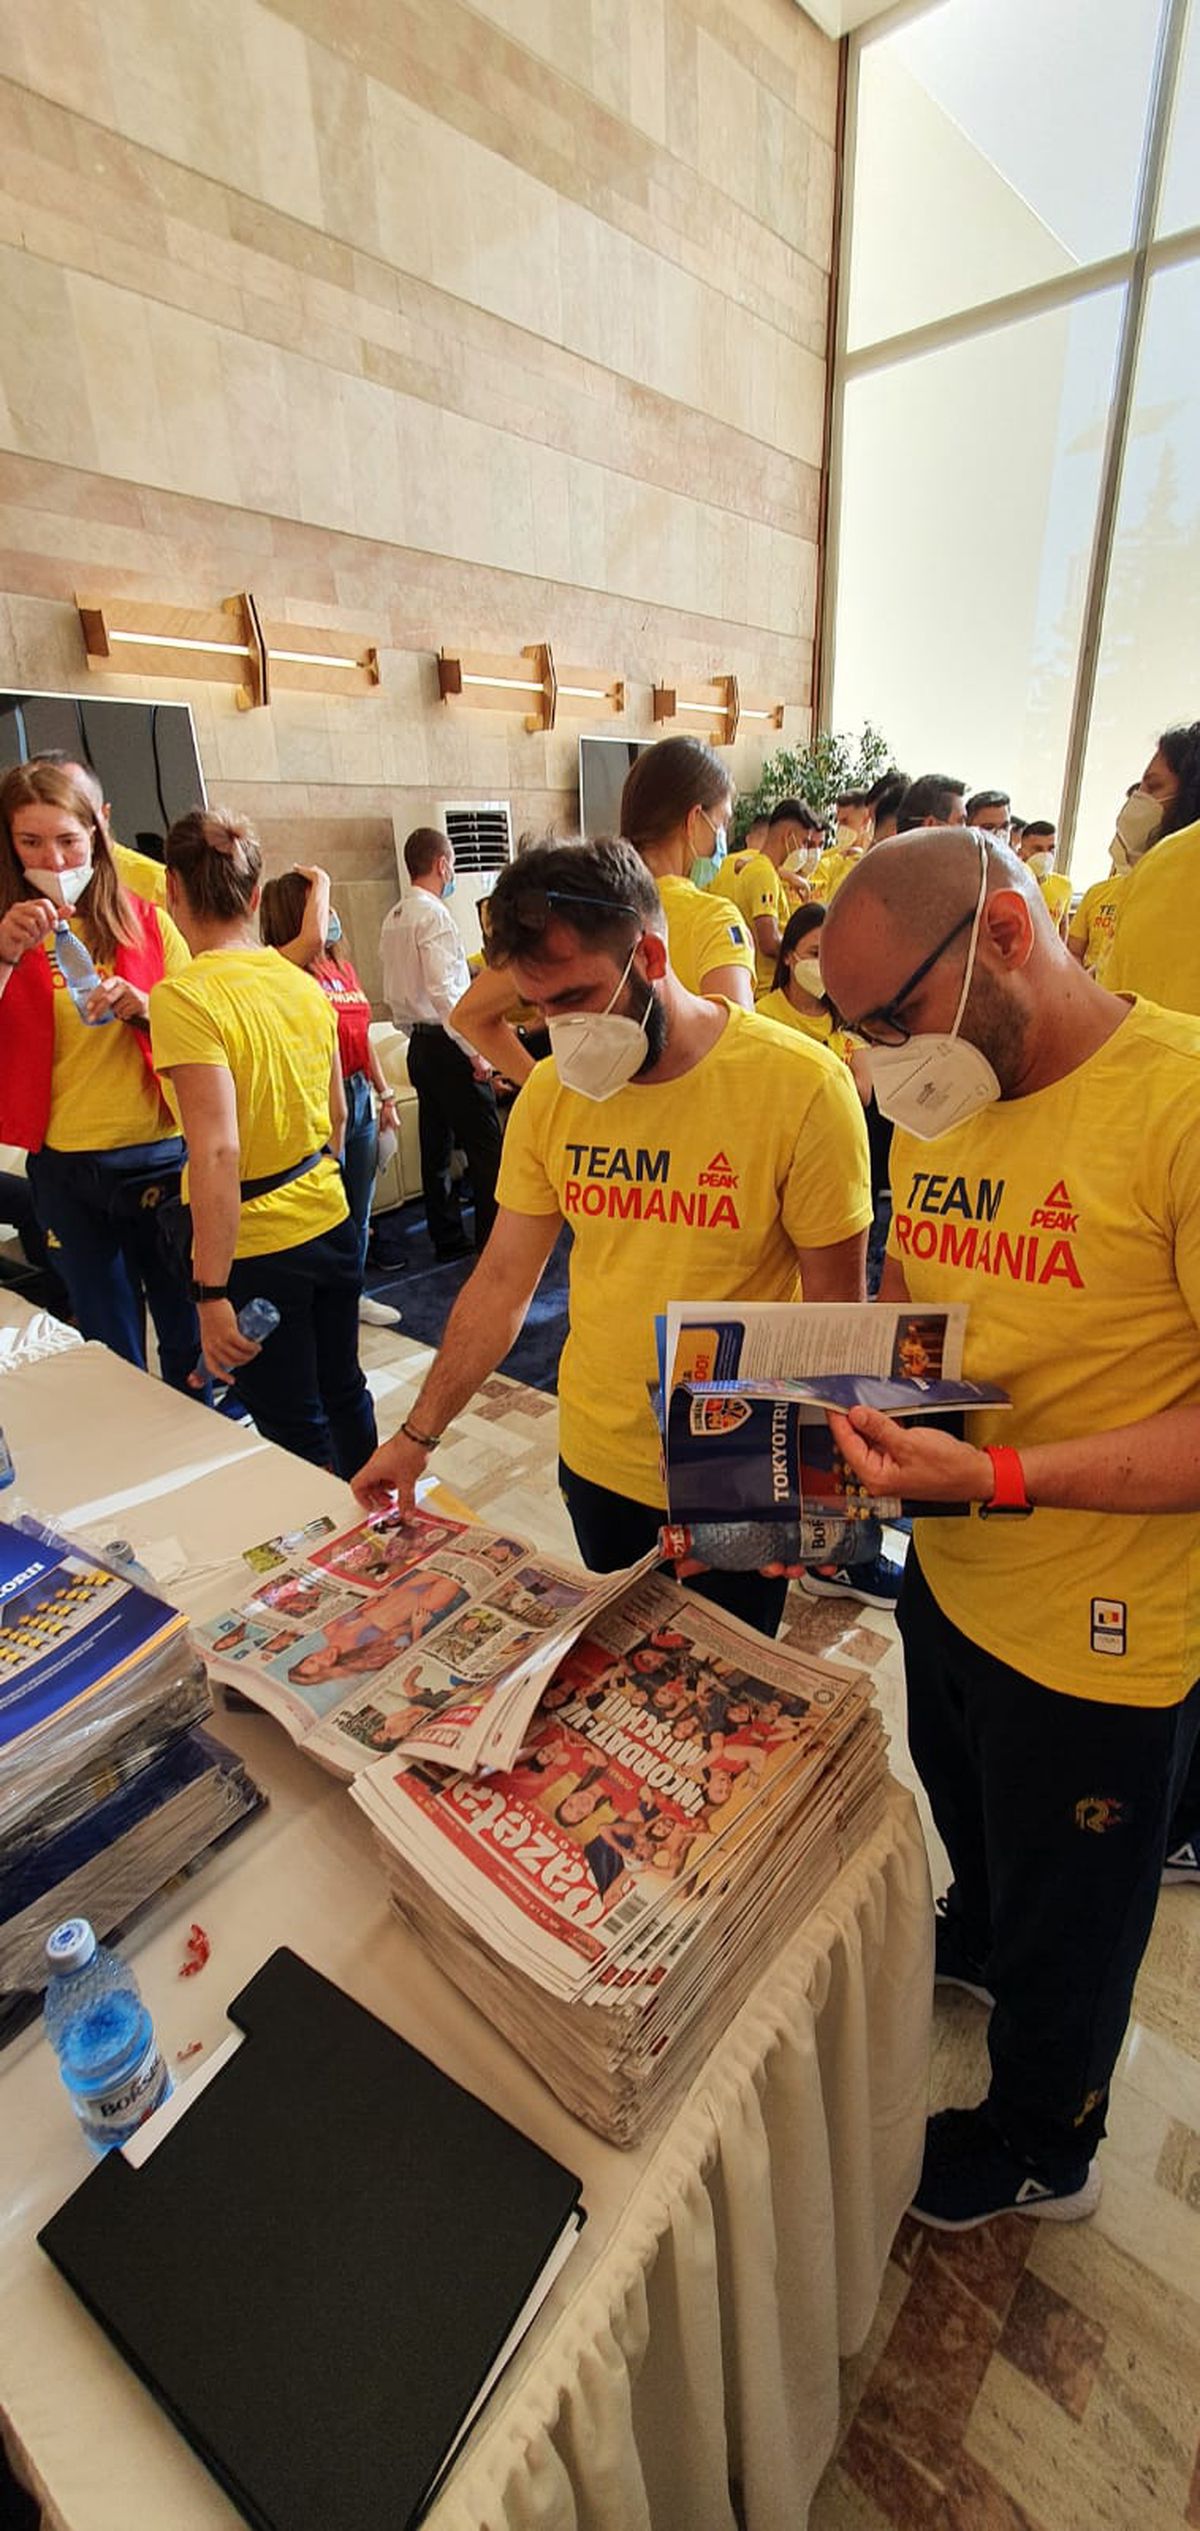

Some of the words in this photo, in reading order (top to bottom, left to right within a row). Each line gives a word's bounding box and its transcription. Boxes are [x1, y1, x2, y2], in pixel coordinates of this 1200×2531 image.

[565, 1144, 670, 1183] TEAM
[699, 1173, 739, 1189] PEAK
[565, 1181, 740, 1230] ROMANIA
[907, 1172, 1005, 1224] TEAM
[1030, 1209, 1079, 1233] PEAK
[895, 1214, 1085, 1289] ROMANIA
[772, 1401, 790, 1502] TOKYOTRI
